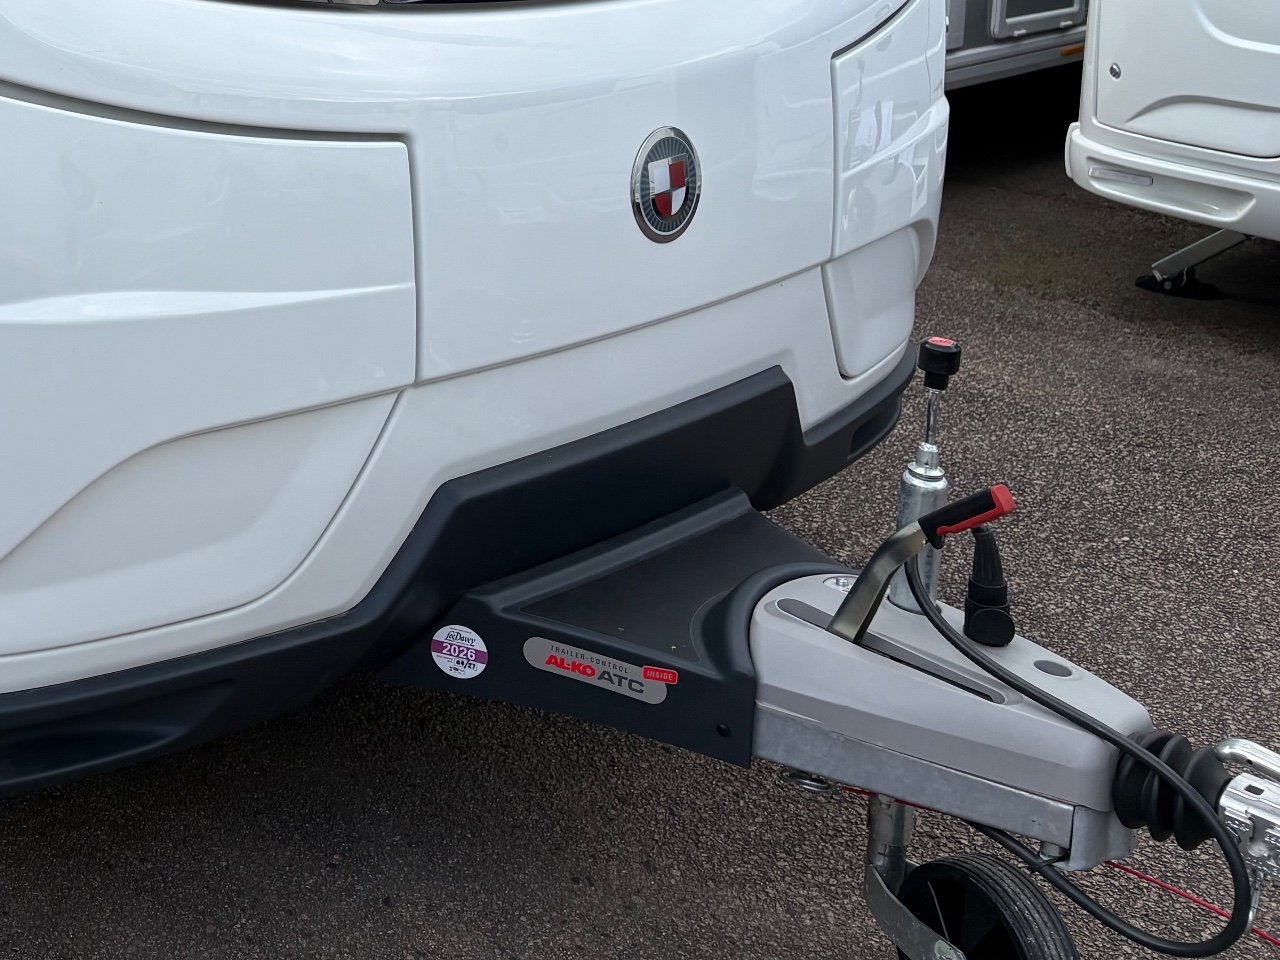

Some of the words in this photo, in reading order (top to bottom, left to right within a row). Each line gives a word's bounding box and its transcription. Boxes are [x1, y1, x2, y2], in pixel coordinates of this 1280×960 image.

[442, 642, 476, 661] 2026
[545, 654, 597, 678] AL-KO
[597, 669, 645, 694] ATC
[646, 669, 673, 681] INSIDE
